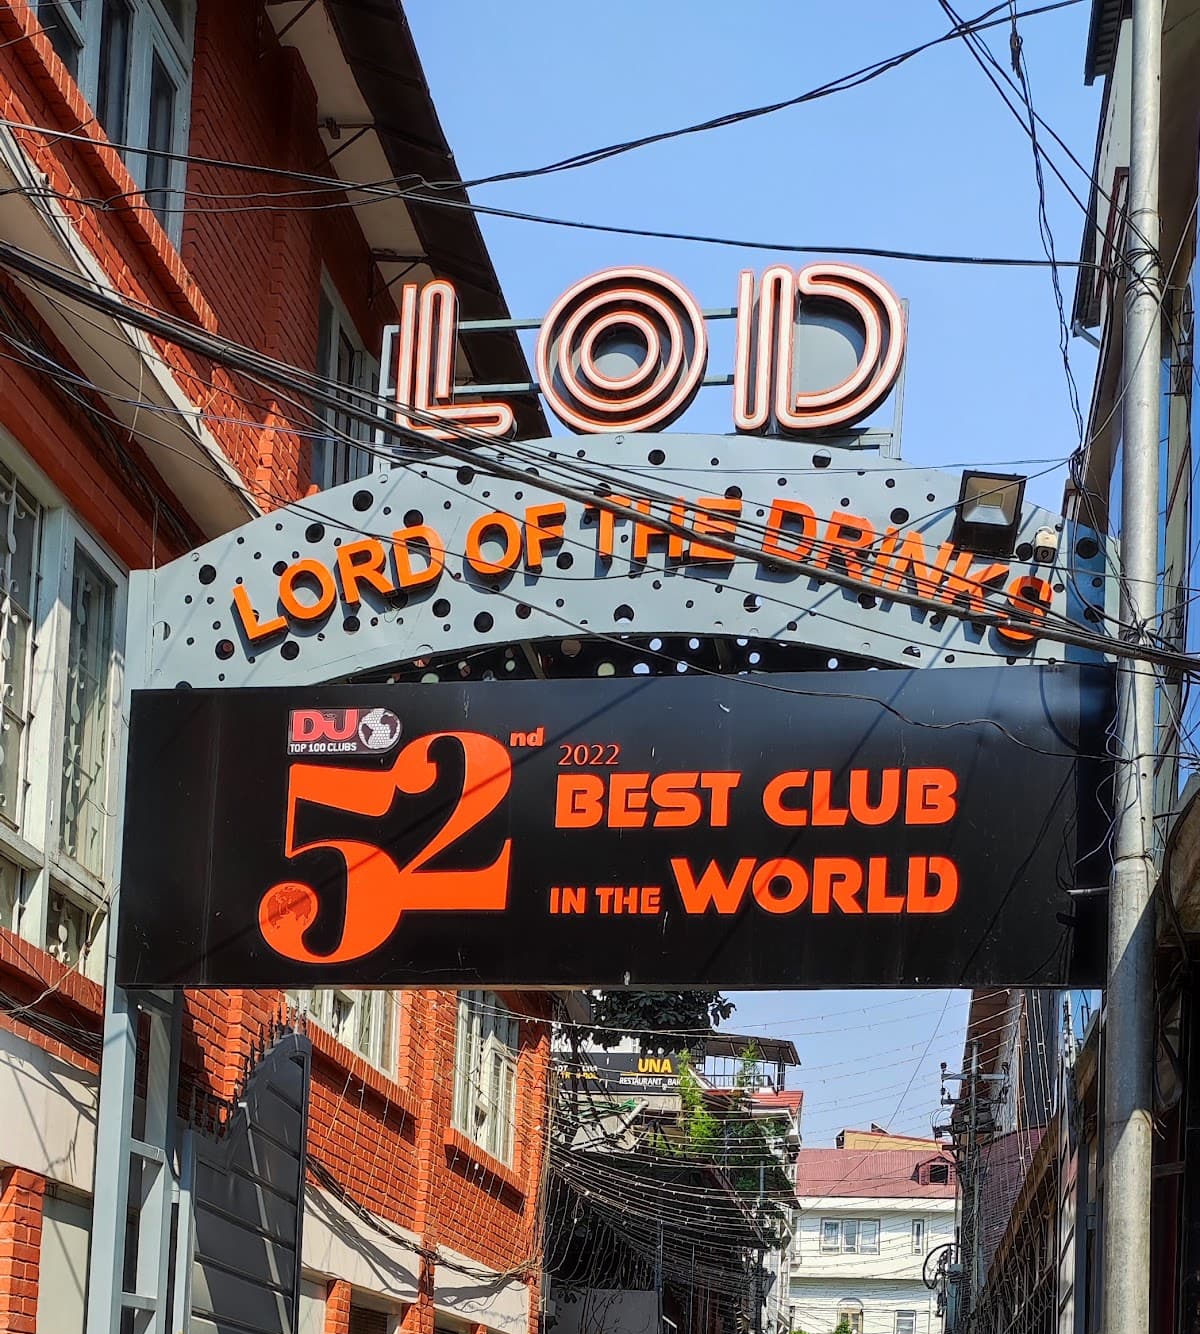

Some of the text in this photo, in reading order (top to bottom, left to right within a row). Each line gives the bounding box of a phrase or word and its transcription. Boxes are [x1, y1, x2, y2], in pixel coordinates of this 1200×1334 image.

[396, 262, 908, 441] LOD
[232, 494, 1056, 647] LORD OF THE DRINKS
[292, 708, 359, 742] DJ
[289, 741, 357, 753] TOP 100 CLUBS
[558, 743, 620, 767] 2022
[555, 768, 958, 829] BEST CLUB
[549, 856, 959, 915] IN THE WORLD
[619, 1076, 662, 1087] RESTAURANT
[637, 1057, 673, 1074] UNA
